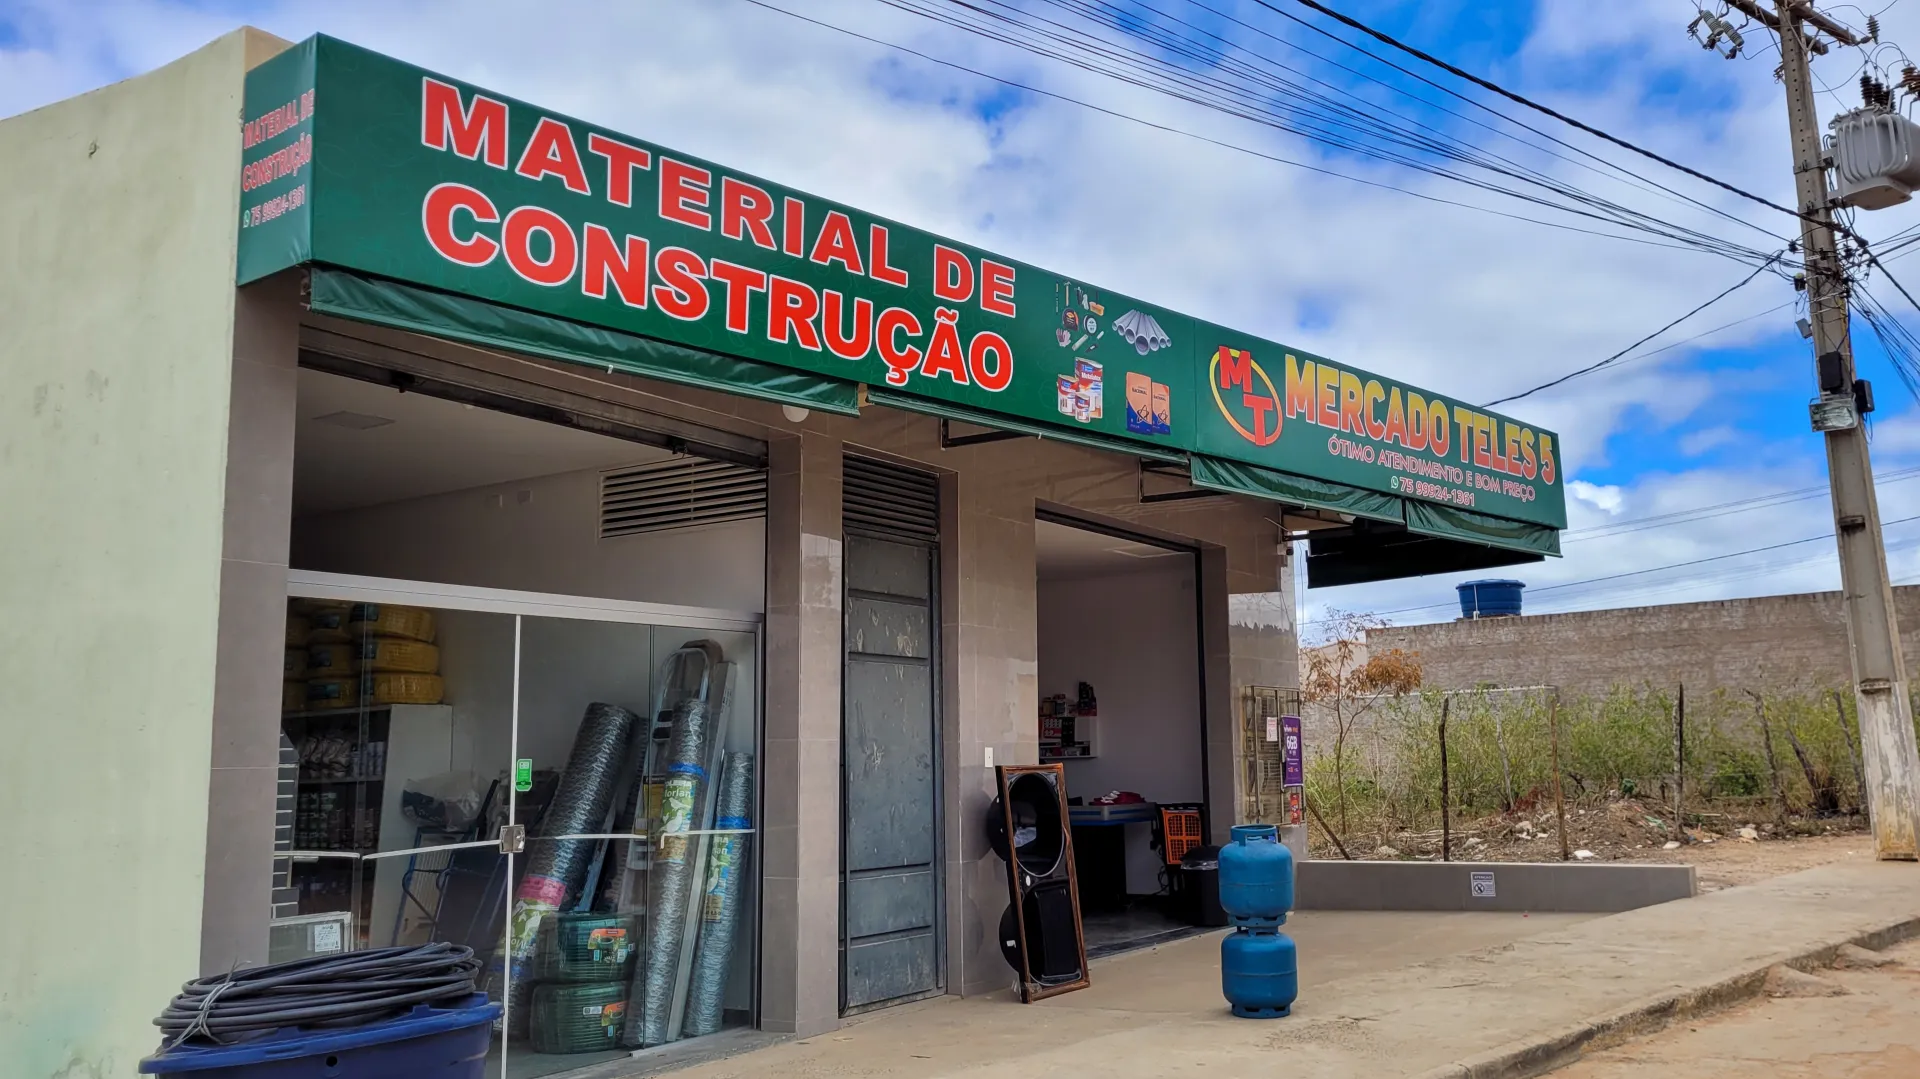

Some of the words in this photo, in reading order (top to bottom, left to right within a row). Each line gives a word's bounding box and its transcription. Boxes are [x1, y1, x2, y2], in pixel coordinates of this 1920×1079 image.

[243, 100, 299, 149] MATERIAL
[301, 88, 315, 121] DE
[243, 132, 312, 192] CONSTRUÇÃO
[251, 205, 261, 227] 75
[422, 77, 908, 288] MATERIAL
[933, 243, 1016, 319] DE
[422, 183, 1013, 393] CONSTRUÇÃO
[1285, 353, 1450, 458] MERCADO
[1454, 406, 1537, 481] TELES
[1539, 432, 1556, 486] 5
[1328, 434, 1375, 465] ÓTIMO
[1378, 448, 1464, 485] ATENDIMENTO
[1466, 470, 1473, 487] E
[1475, 472, 1501, 494] BOM
[1503, 479, 1536, 503] PREÇO
[1400, 476, 1414, 494] 75
[1416, 481, 1475, 507] 99924-1361
